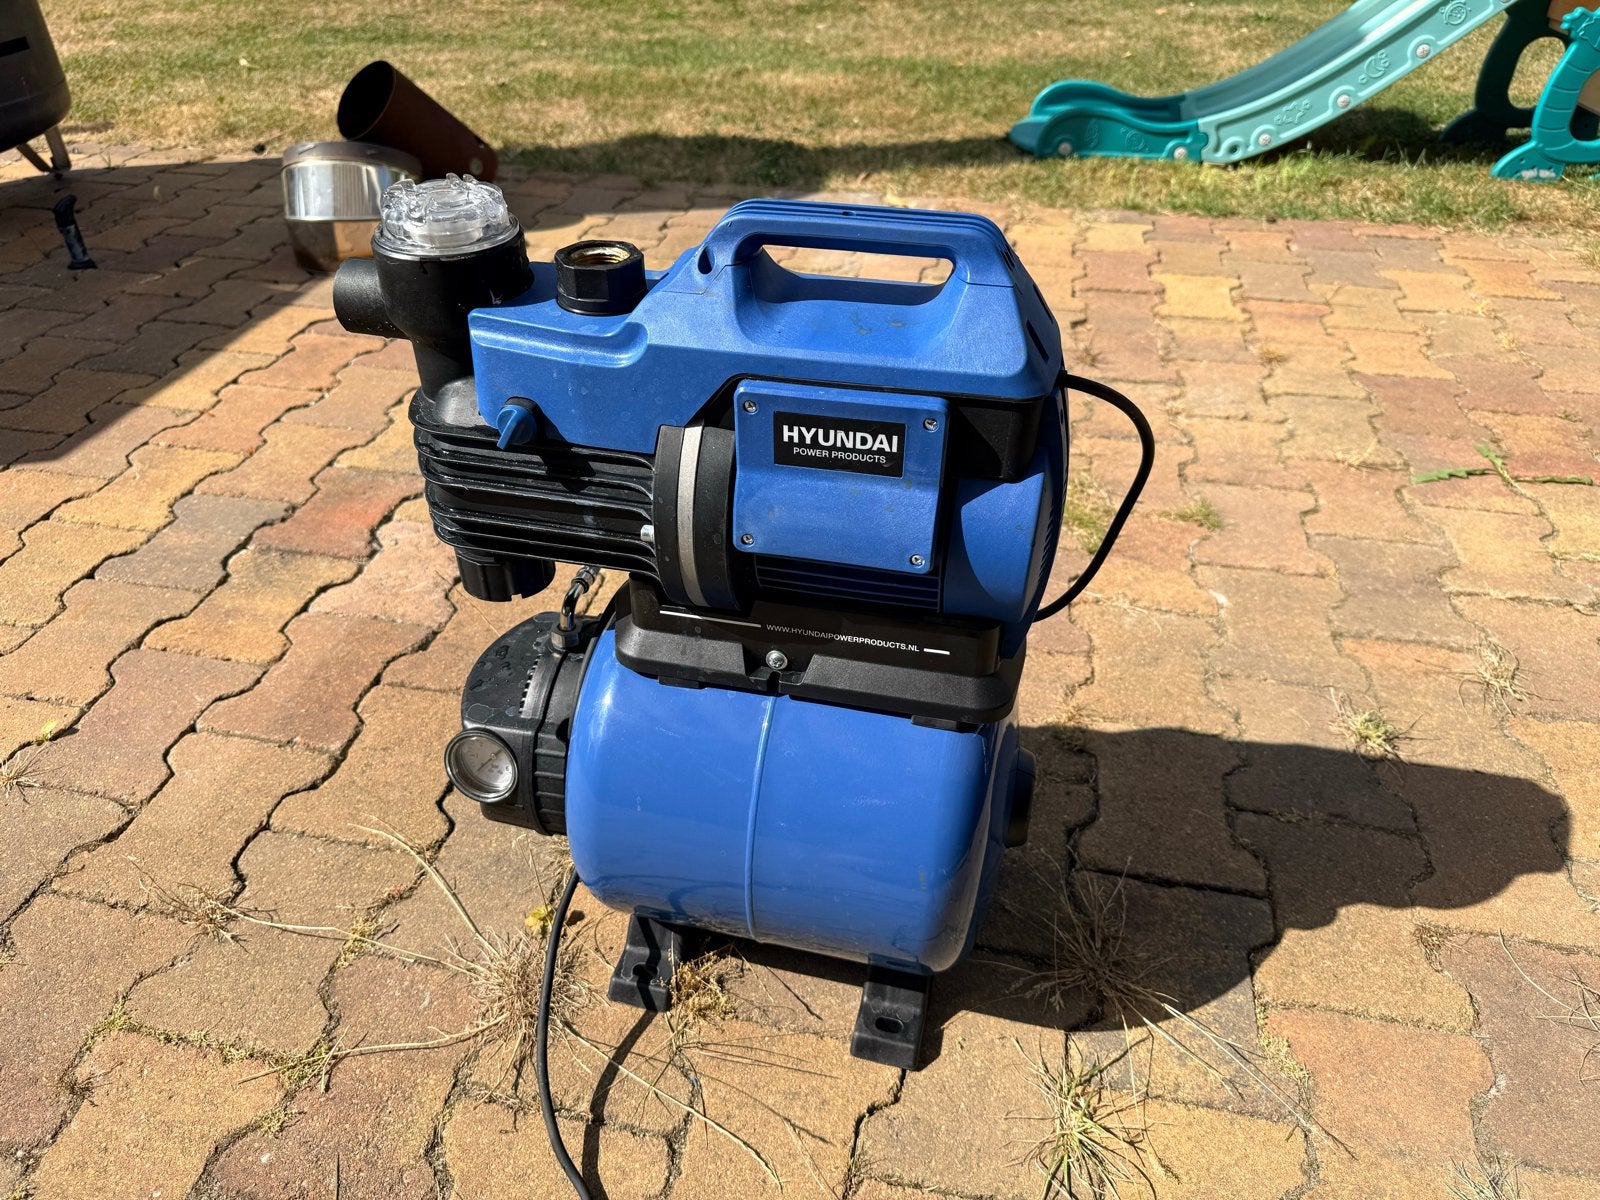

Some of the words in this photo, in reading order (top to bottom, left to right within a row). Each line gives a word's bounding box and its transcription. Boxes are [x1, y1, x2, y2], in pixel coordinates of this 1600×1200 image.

[782, 424, 899, 453] HYUNDAI
[793, 447, 829, 458] POWER
[831, 451, 887, 464] PRODUCTS
[766, 624, 920, 652] WWW.HYUNDAIPOWERPRODUCTS.NL
